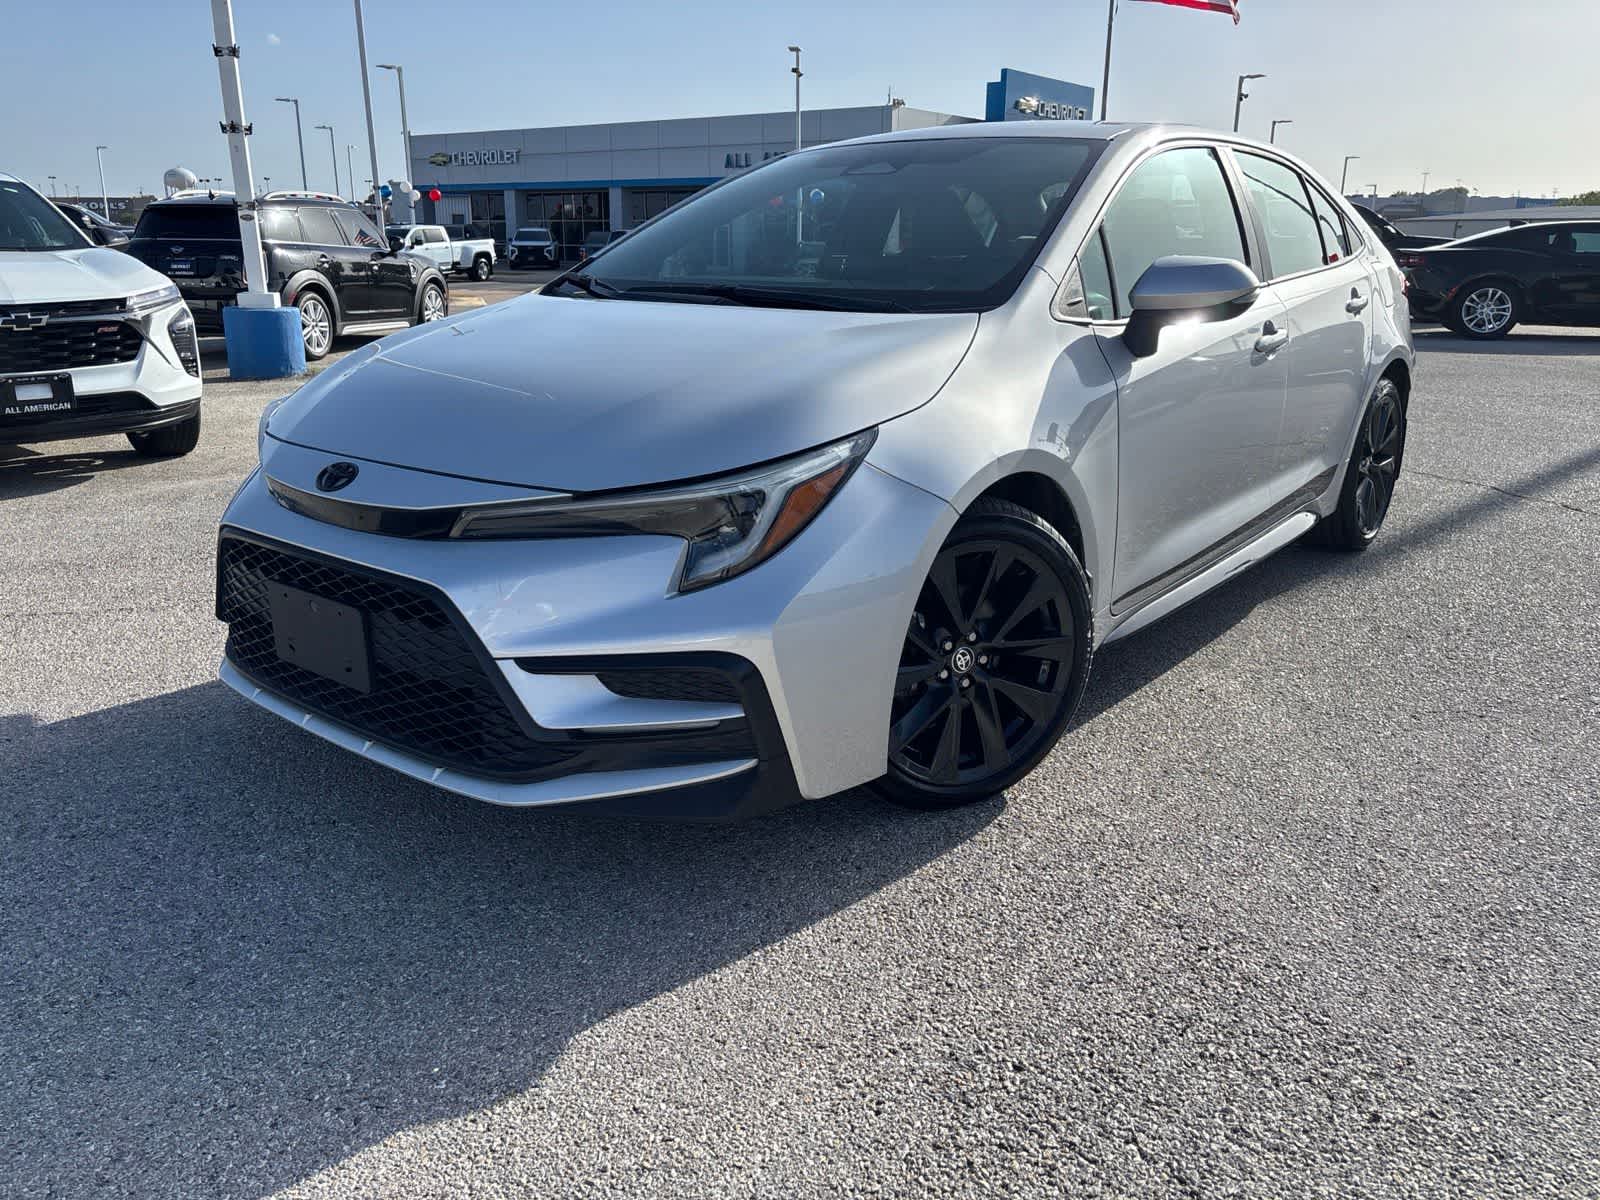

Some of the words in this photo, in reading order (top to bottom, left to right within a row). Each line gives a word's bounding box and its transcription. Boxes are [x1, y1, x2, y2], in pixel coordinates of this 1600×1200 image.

[451, 150, 518, 166] CHEVROLET
[724, 152, 752, 168] ALL
[23, 402, 71, 413] AMERICAN
